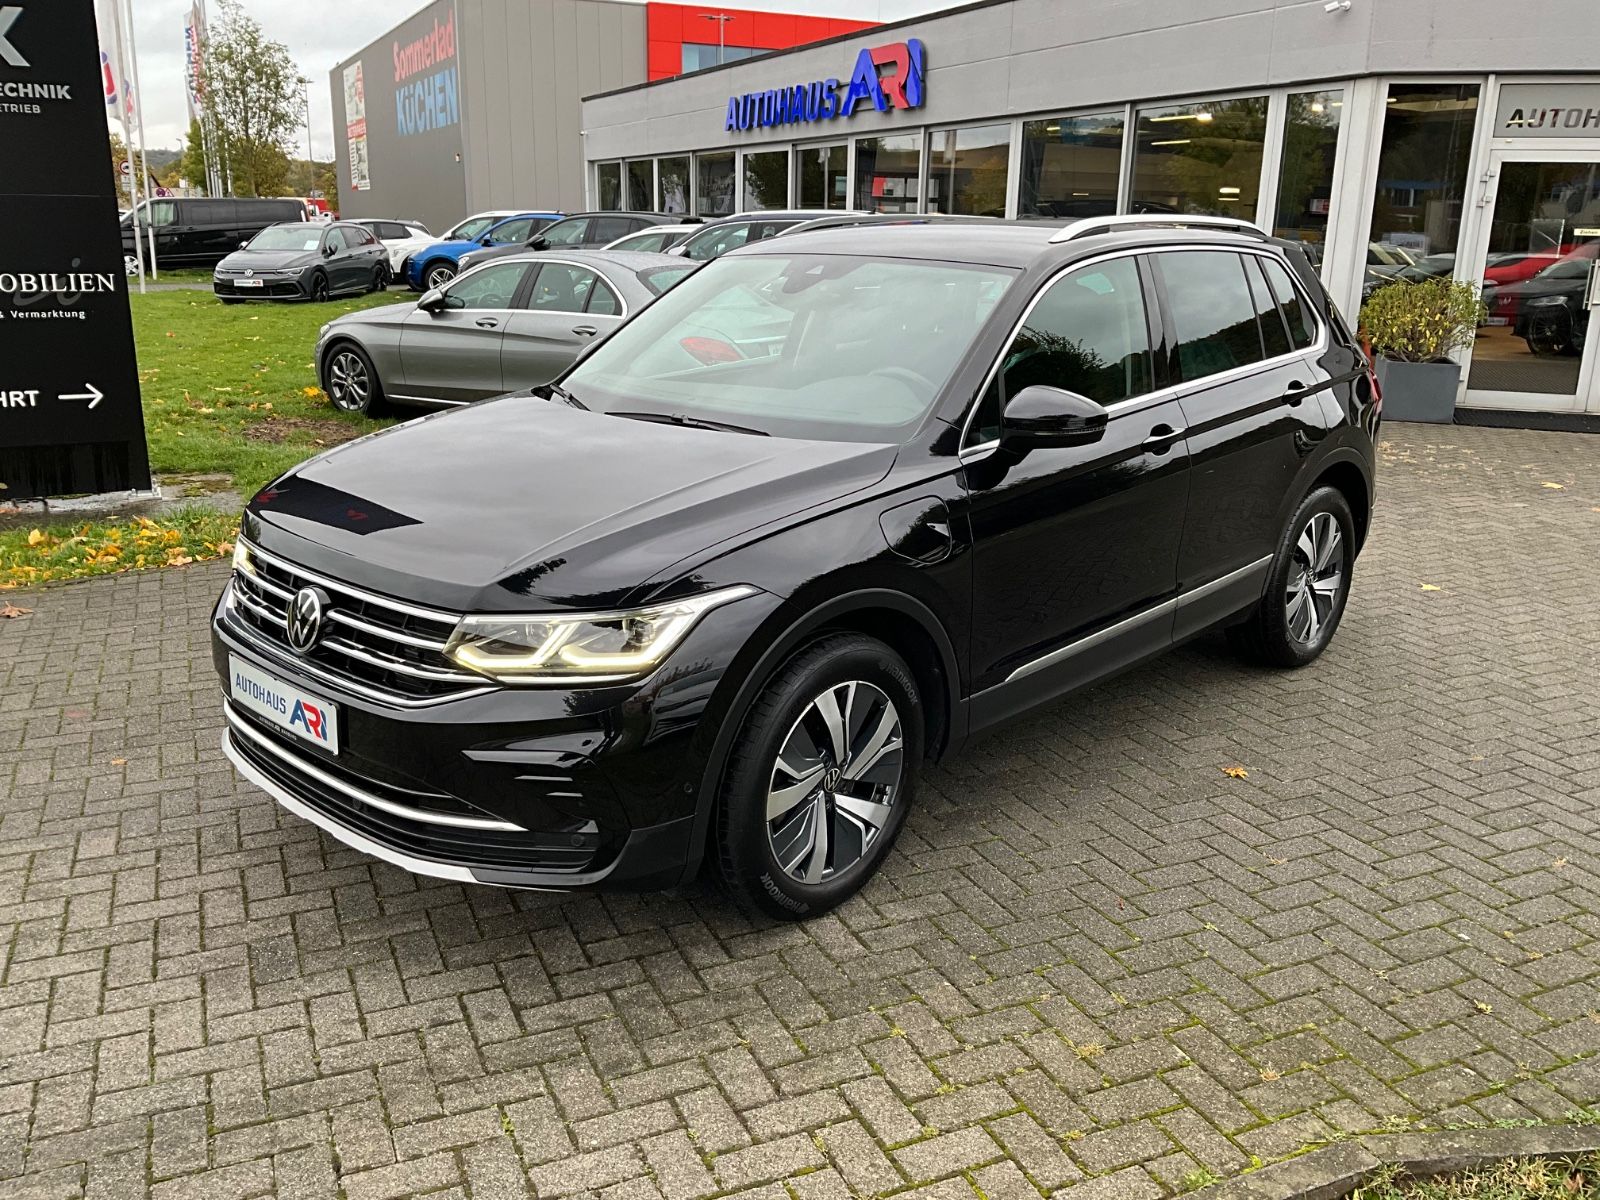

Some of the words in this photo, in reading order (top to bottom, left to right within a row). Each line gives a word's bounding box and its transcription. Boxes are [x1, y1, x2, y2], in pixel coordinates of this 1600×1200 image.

[393, 9, 455, 83] Sommerlad
[725, 78, 840, 132] AUTOHAUS
[840, 38, 926, 117] ARI
[0, 273, 116, 293] OBILIEN
[10, 309, 86, 320] Vermarktung
[235, 672, 287, 715] AUTOHAUS
[289, 698, 328, 742] ARI
